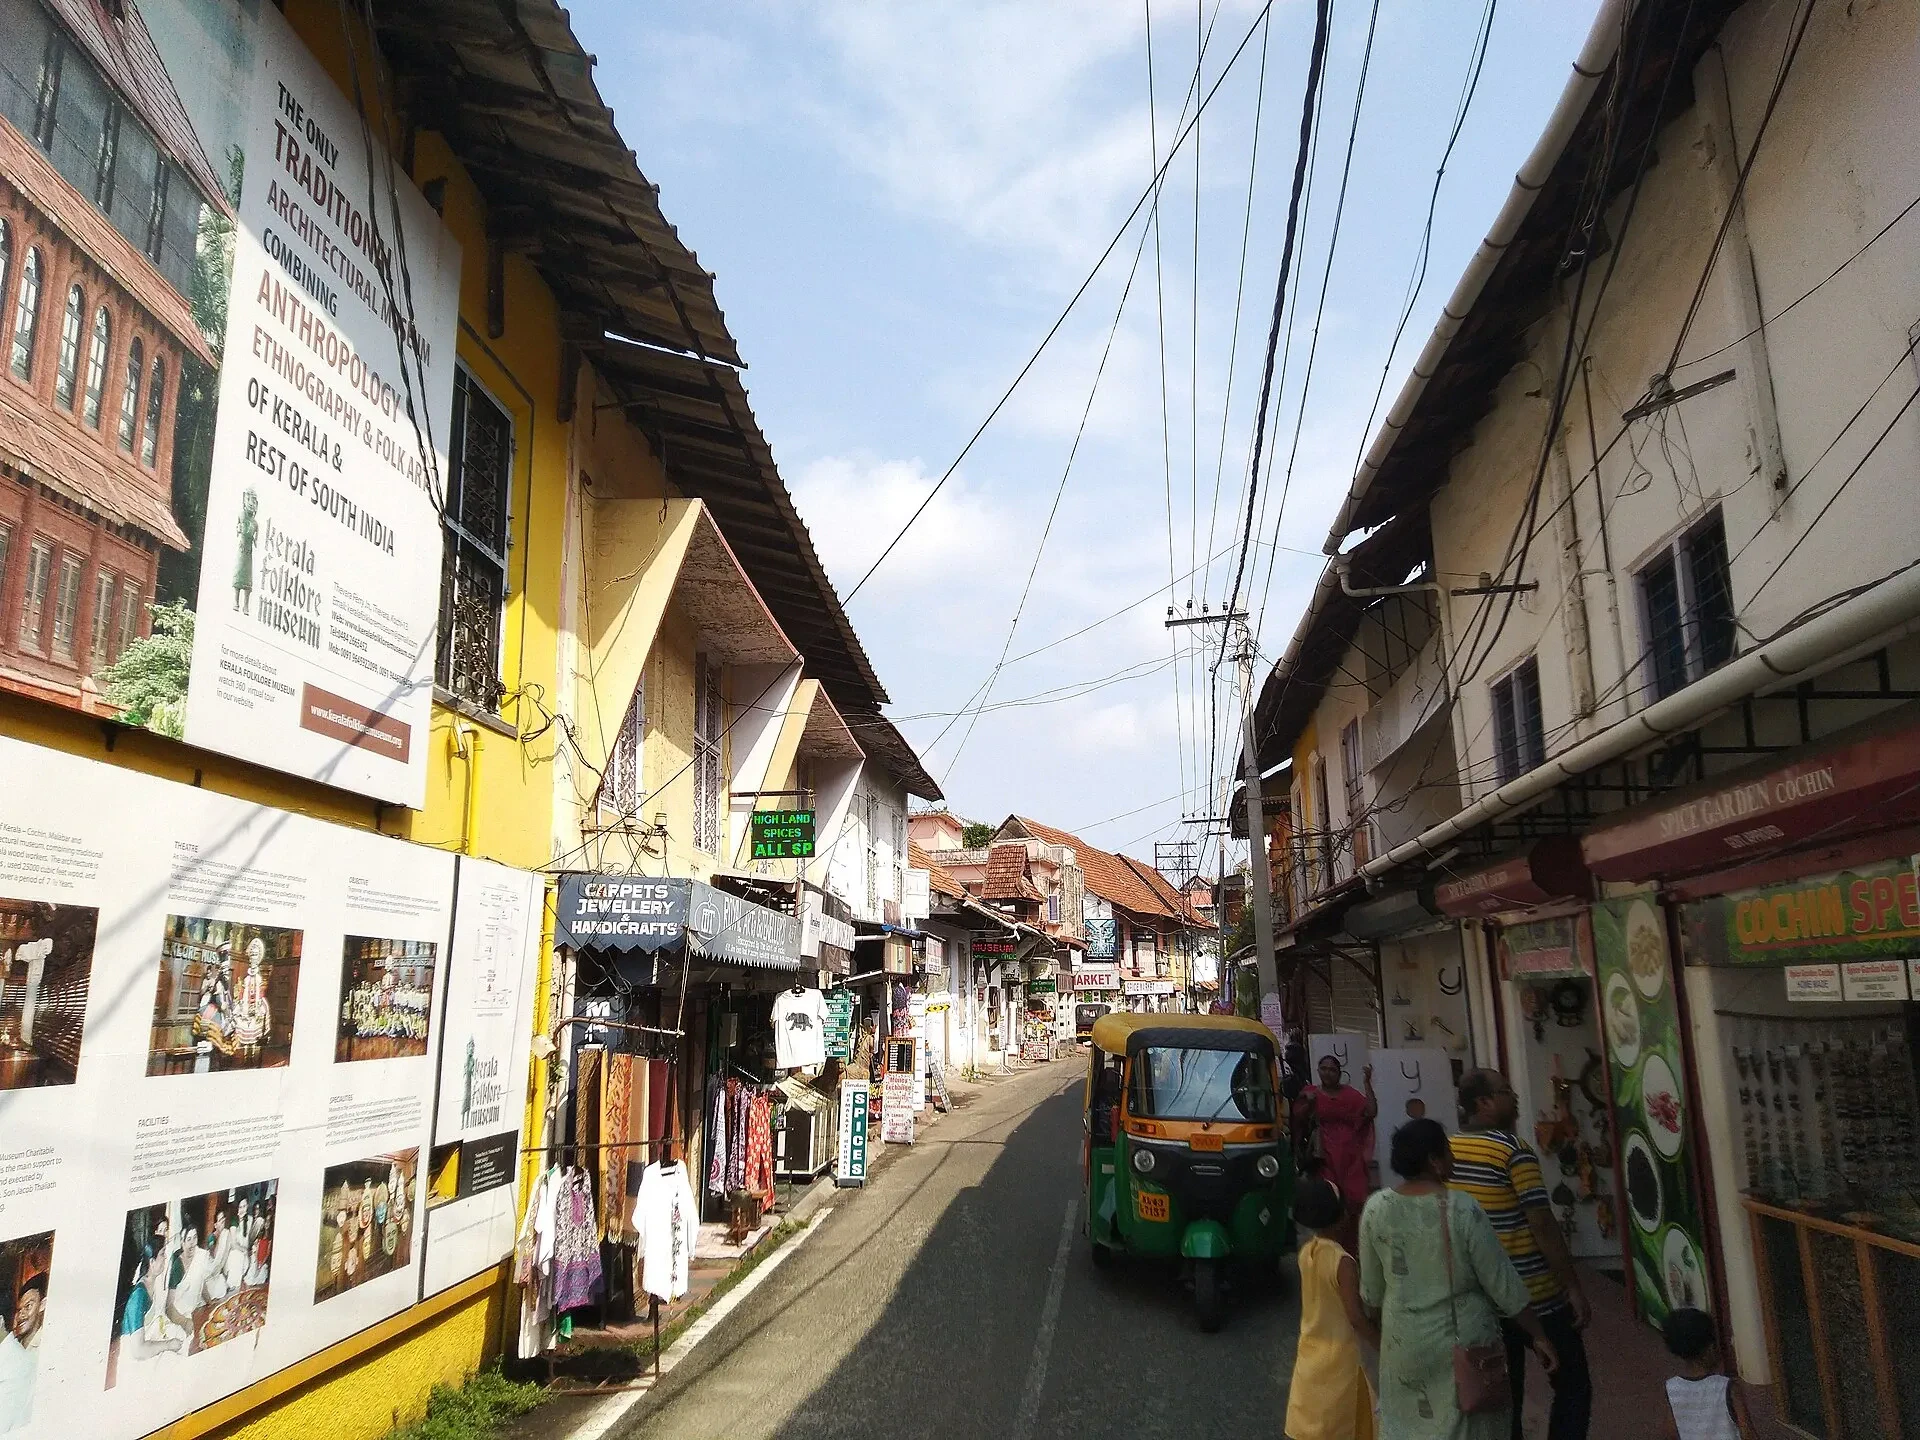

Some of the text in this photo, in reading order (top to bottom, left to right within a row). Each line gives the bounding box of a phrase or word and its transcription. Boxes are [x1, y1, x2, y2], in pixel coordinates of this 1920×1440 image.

[277, 80, 339, 172] THE ONLY
[262, 227, 338, 319] COMBINING
[266, 179, 378, 315] ARCHITECTURAL
[256, 268, 402, 423] ANTHROPOLOGY
[247, 376, 344, 474] OF KERALA &
[251, 323, 362, 437] ETHNOGRAPHY
[363, 418, 373, 449] &
[375, 428, 406, 476] FOLK
[245, 429, 396, 557] REST OF SOUTH INDIA
[264, 516, 316, 578] kerala
[259, 552, 322, 617] folklore
[256, 593, 322, 651] museum
[219, 659, 296, 697] KERALA FOLKLORE MUSEUM
[753, 813, 811, 825] HIGH LAND
[763, 827, 802, 838] SPICES
[1659, 766, 1836, 839] SPICE GARDEN COCHIN
[754, 843, 786, 857] ALL
[576, 898, 676, 915] JEWELLERY
[584, 882, 669, 899] CARPETS
[620, 913, 631, 922] &
[1736, 884, 1845, 945] COCHIN
[571, 920, 678, 936] HANDICRAFTS
[972, 943, 1015, 953] MUSEUM
[851, 1093, 866, 1175] SPICES
